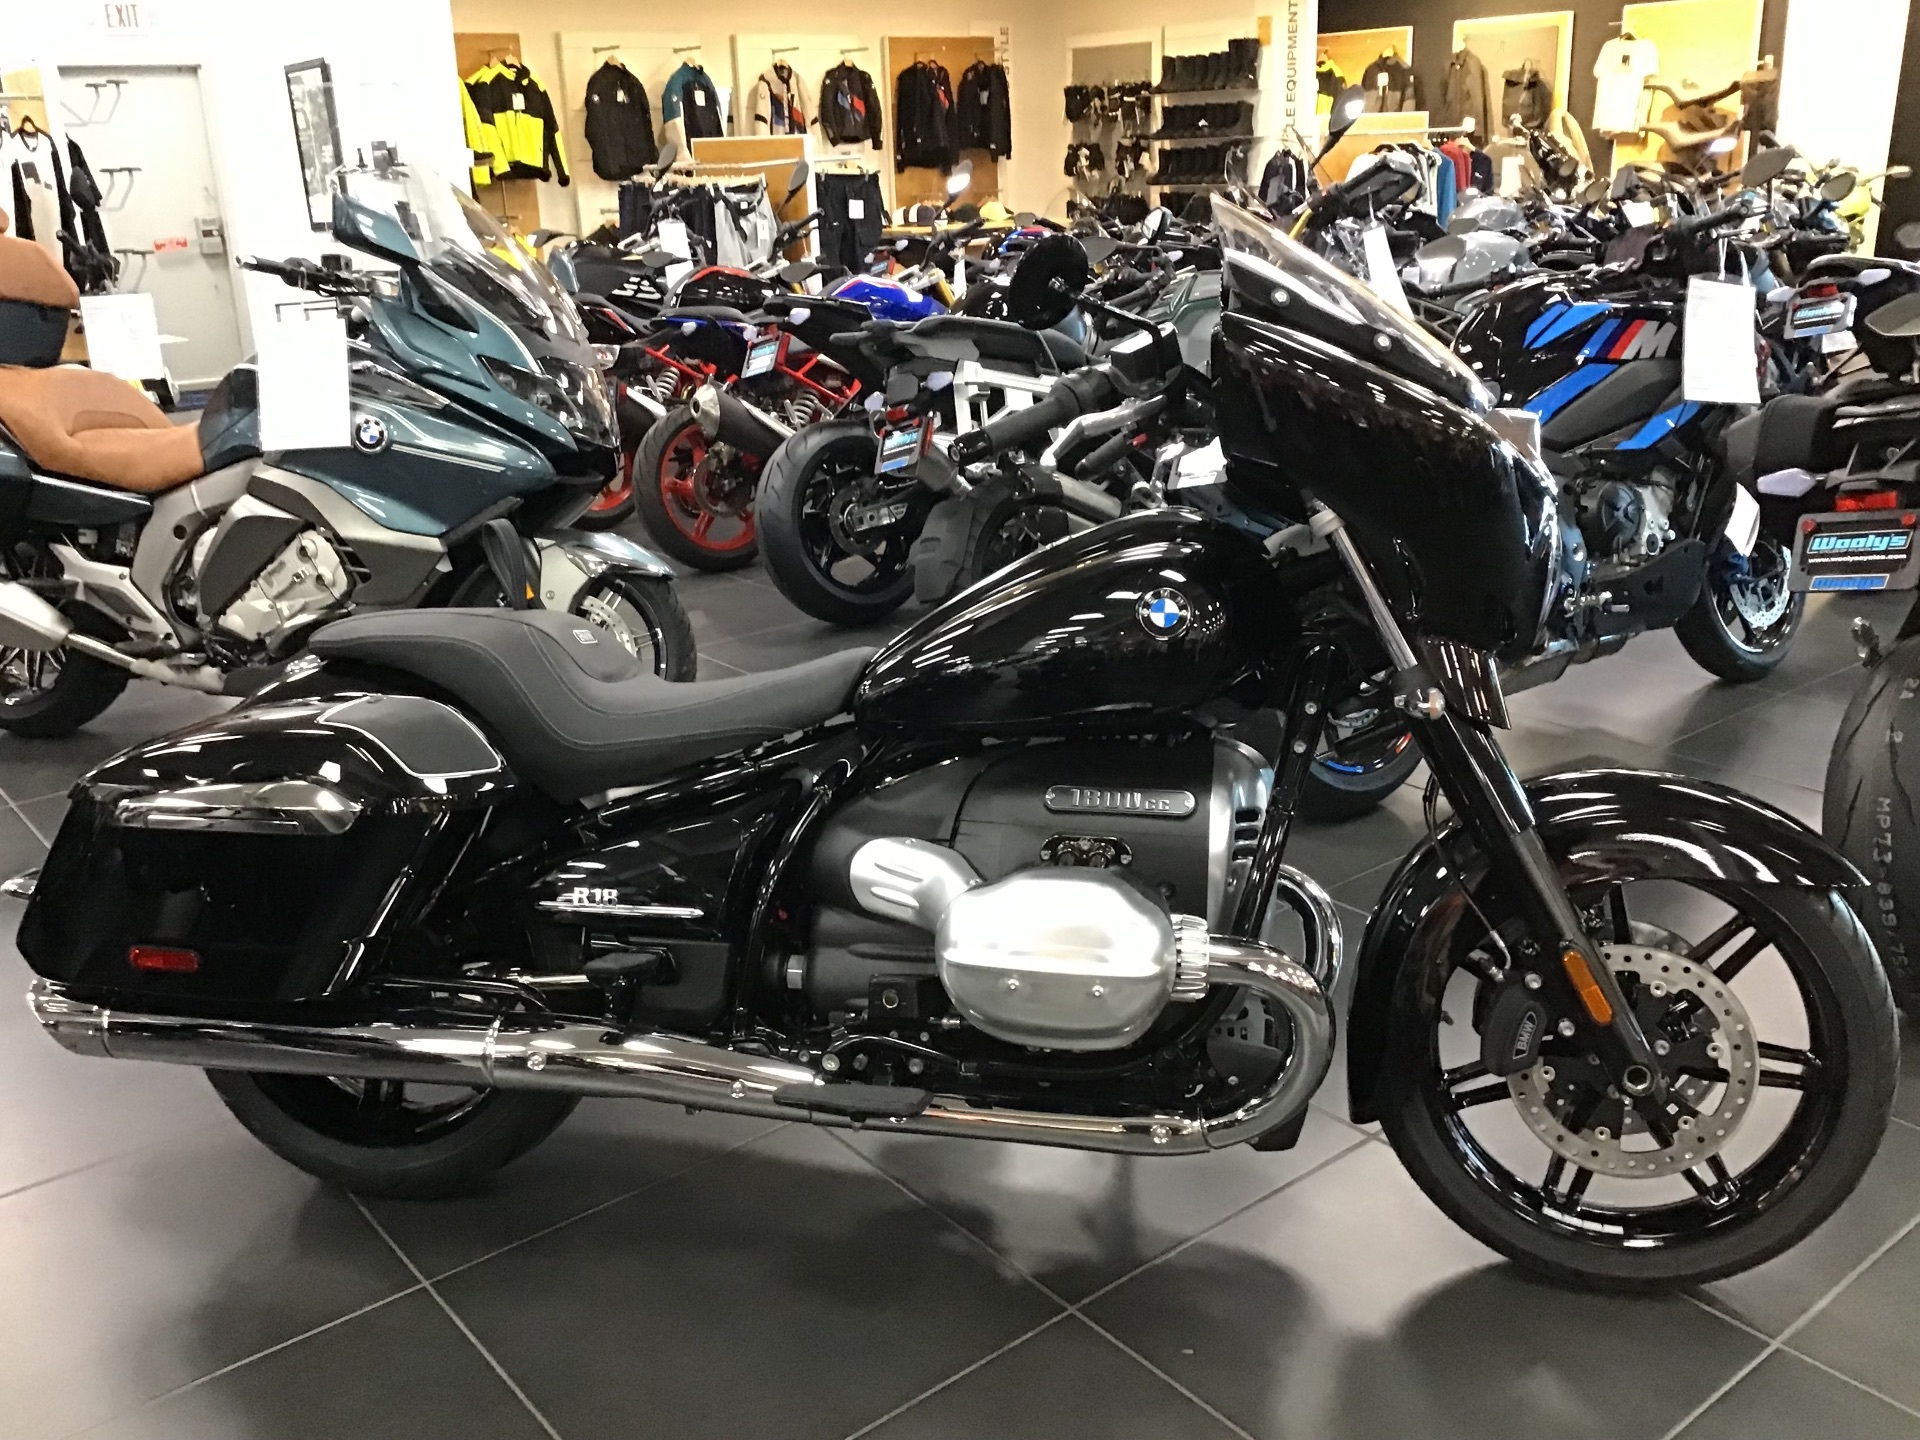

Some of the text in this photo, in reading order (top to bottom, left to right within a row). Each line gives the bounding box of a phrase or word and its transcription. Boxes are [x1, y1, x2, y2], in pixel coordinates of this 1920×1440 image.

[104, 3, 138, 28] EXIT
[1286, 0, 1299, 103] EQUIPMENT
[1811, 533, 1908, 552] Wooly's
[1070, 788, 1170, 811] 1800cc
[573, 886, 619, 906] R18
[1516, 1020, 1536, 1050] BMW
